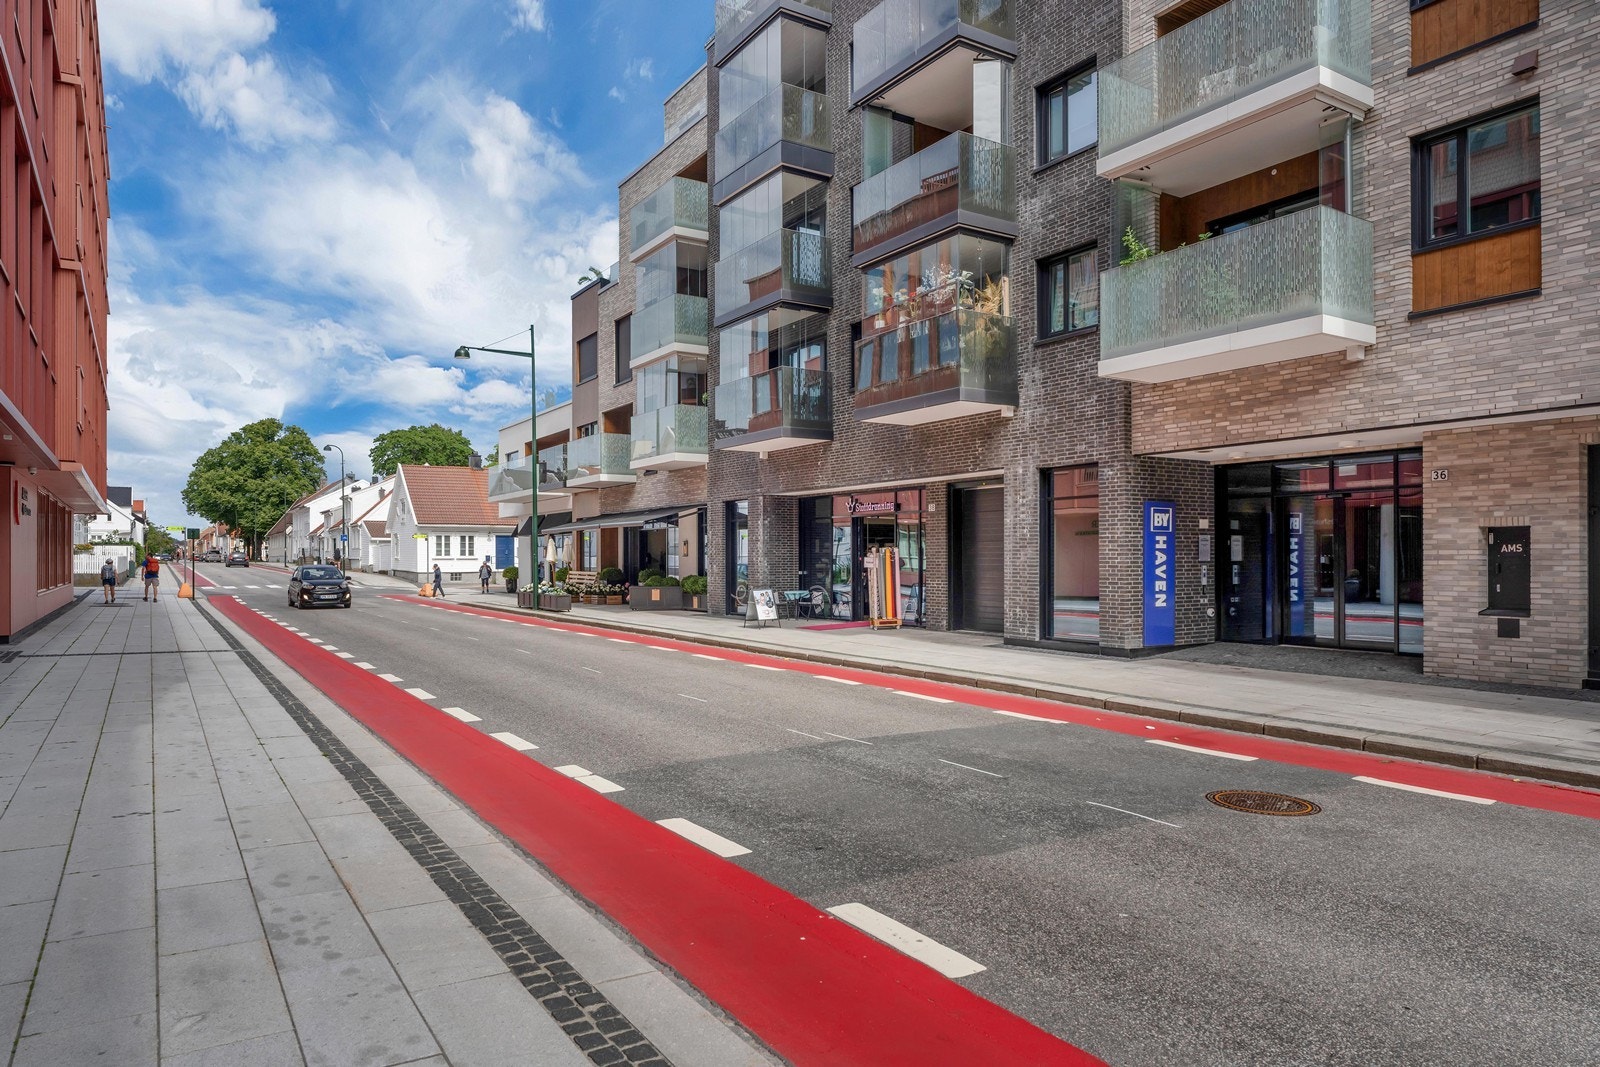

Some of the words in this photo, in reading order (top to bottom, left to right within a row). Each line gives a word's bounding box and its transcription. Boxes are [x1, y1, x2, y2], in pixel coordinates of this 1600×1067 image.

[1433, 470, 1446, 480] 36
[1154, 513, 1169, 527] BY
[1500, 543, 1523, 553] AMS
[1155, 536, 1167, 607] HAVEN
